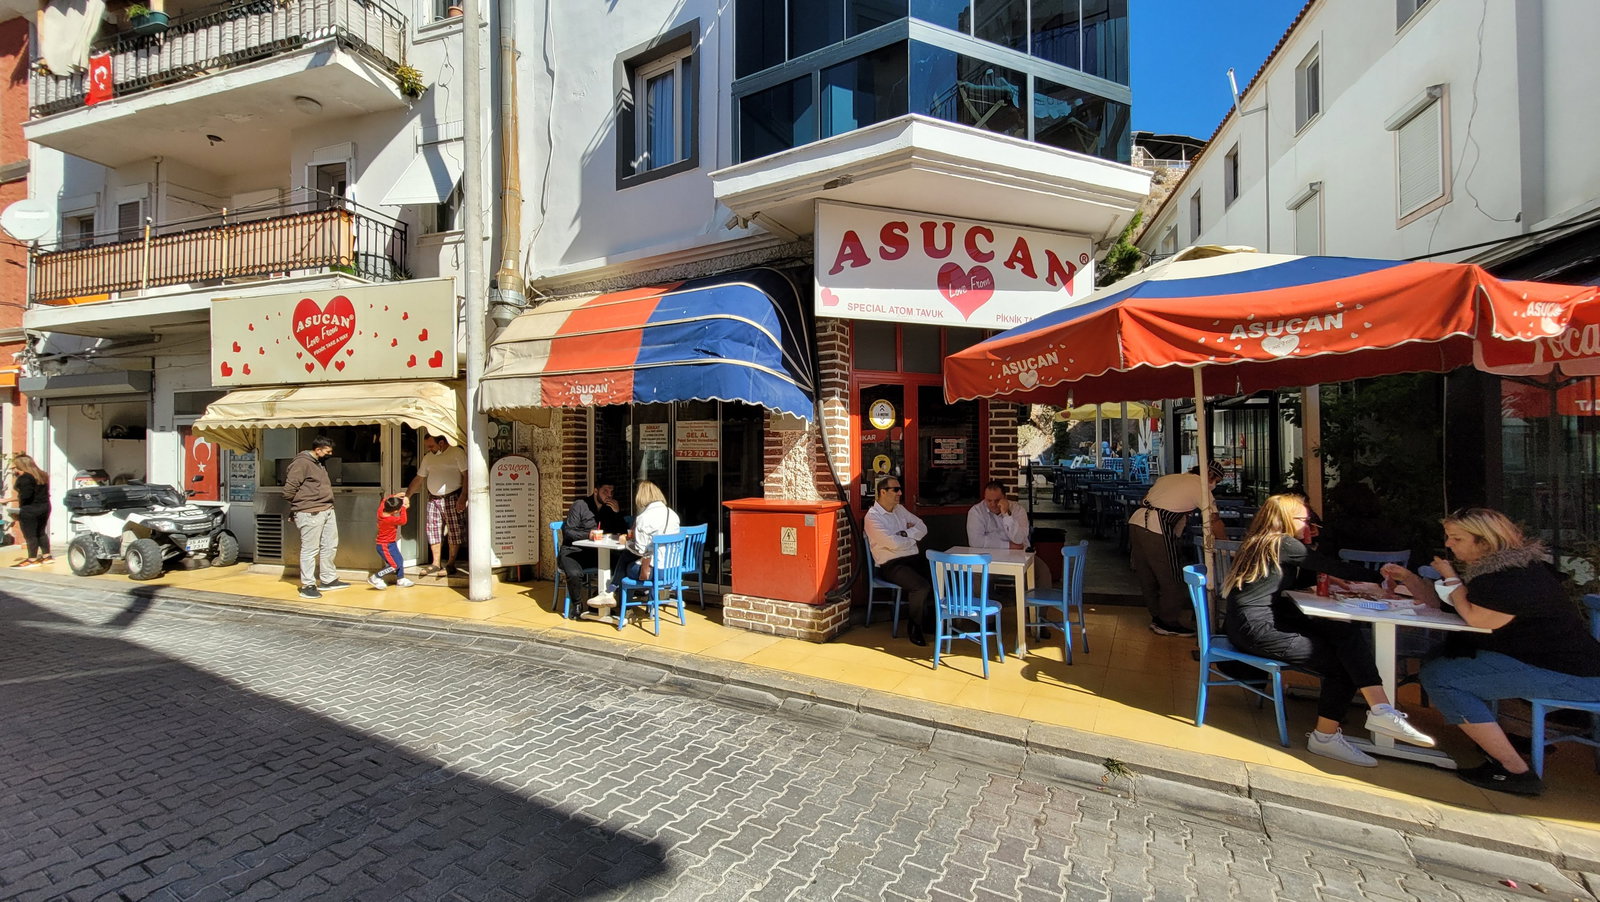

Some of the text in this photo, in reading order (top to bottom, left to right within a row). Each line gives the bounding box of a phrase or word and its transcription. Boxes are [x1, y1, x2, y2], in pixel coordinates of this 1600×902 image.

[948, 275, 990, 298] Love From
[847, 302, 944, 318] SPECIAL ATOM TAVUK
[996, 313, 1022, 324] PİKNİK
[1229, 313, 1343, 340] ASUCAN
[1002, 352, 1058, 376] ASUCAN
[570, 384, 608, 394] ASUCAN
